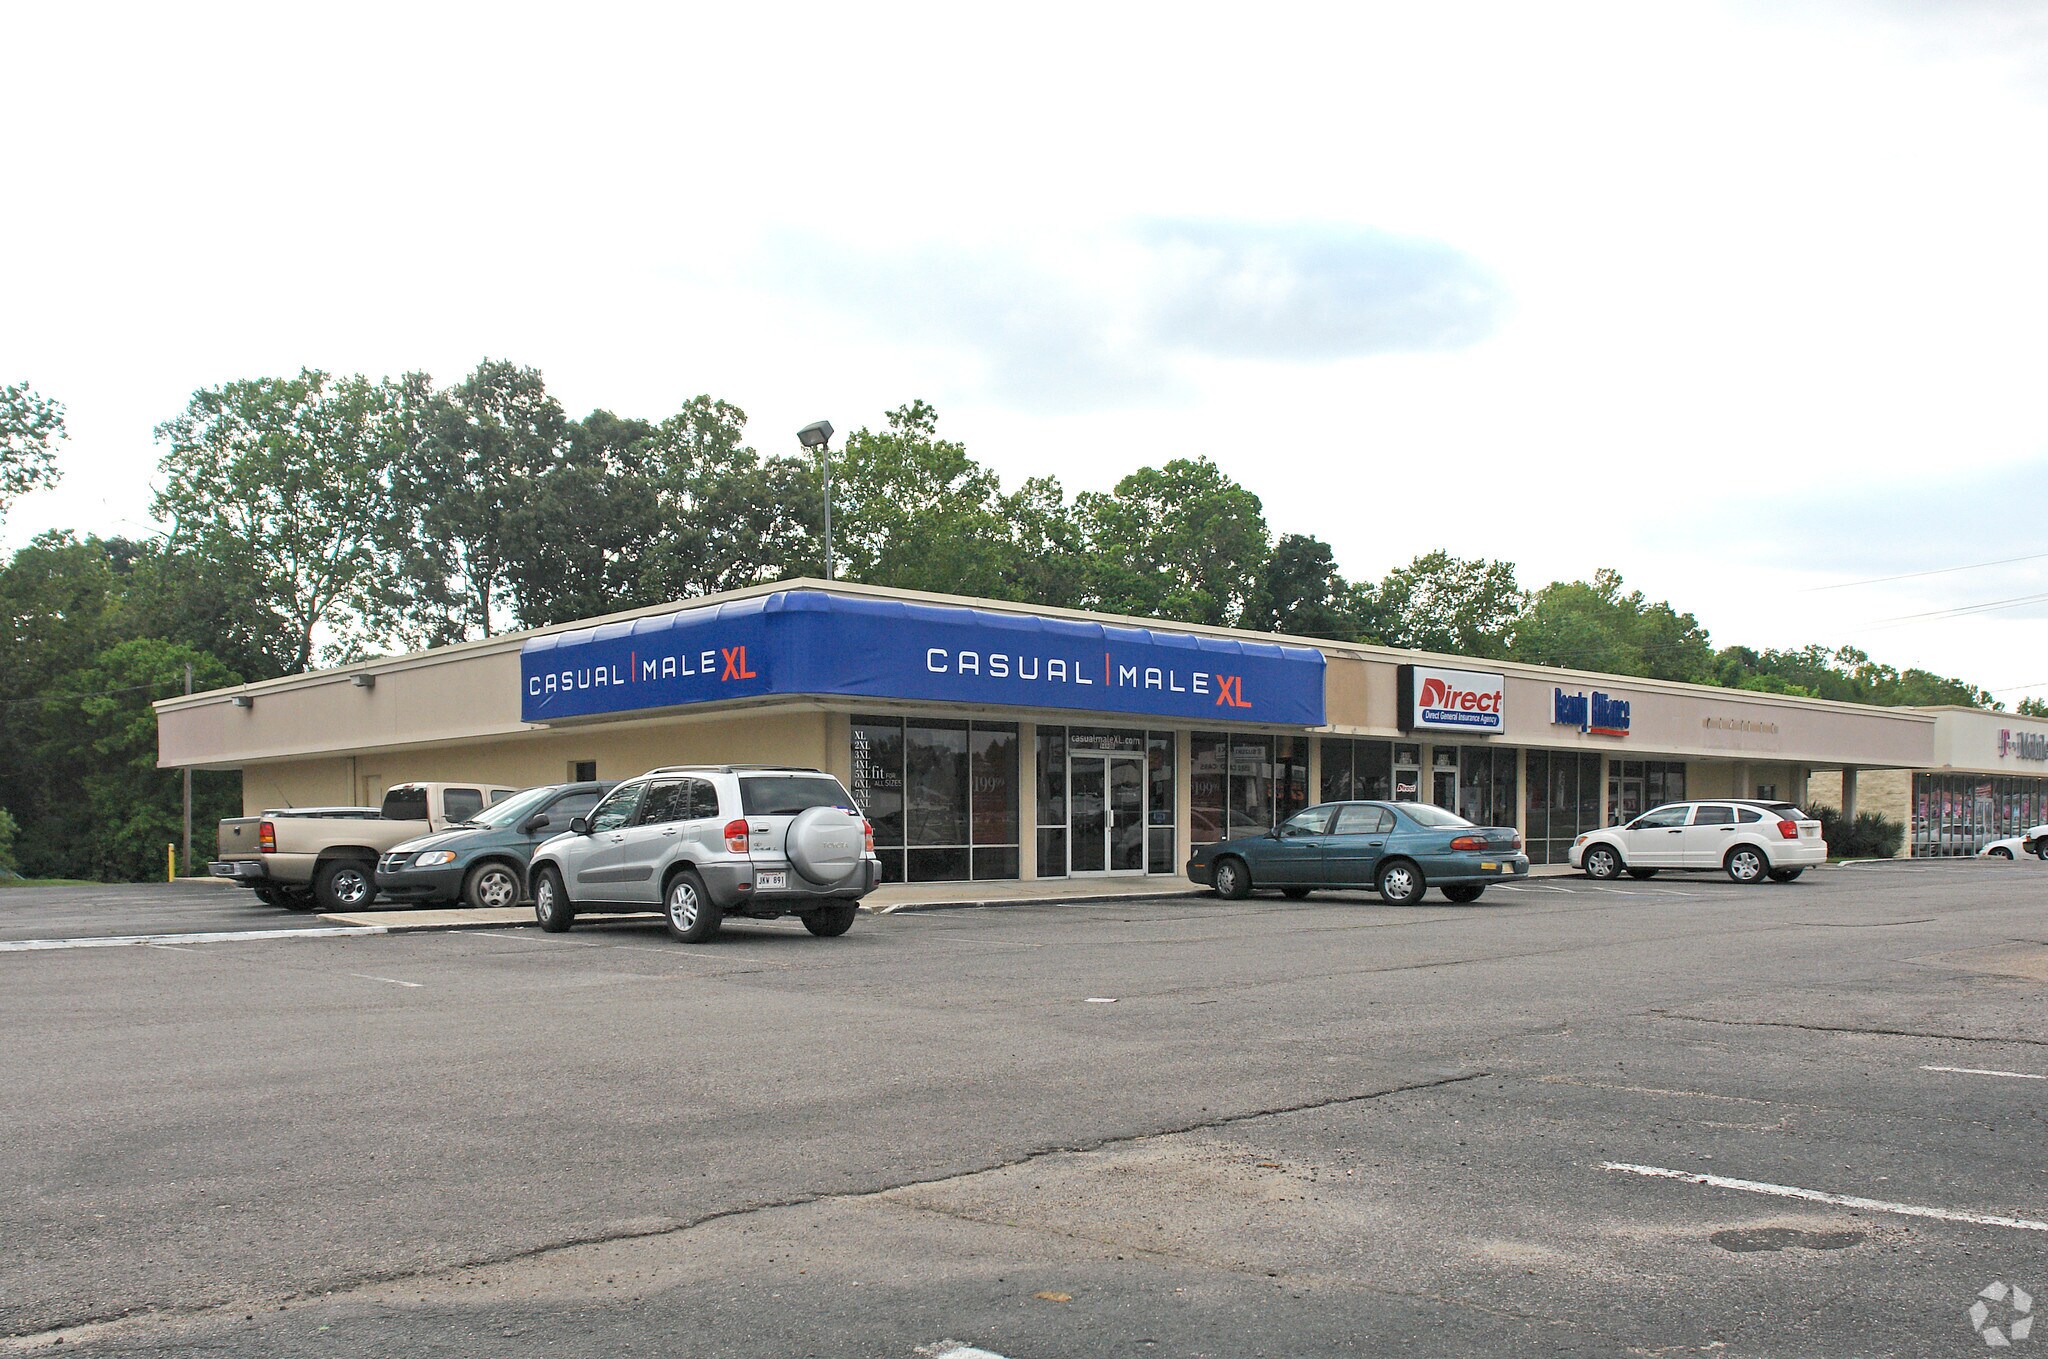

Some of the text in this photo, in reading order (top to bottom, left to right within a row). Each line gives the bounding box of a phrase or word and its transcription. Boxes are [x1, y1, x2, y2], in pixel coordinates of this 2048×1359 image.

[529, 645, 757, 696] CASUAL MALE XL
[926, 647, 1252, 708] CASUAL MALE XL
[1419, 677, 1503, 713] Direct
[1425, 710, 1497, 725] Direct General Insurance Agency
[854, 730, 867, 740] XL
[1071, 733, 1141, 745] casualmaleXL.com
[854, 741, 870, 750] 2XL
[854, 750, 871, 759] 3XL
[854, 760, 871, 769] 4XL
[854, 769, 871, 778] 5XL
[871, 765, 885, 779] fit
[854, 779, 871, 788] 6XL
[854, 789, 871, 798] 7XL
[823, 841, 849, 849] TOYOTA
[773, 876, 784, 884] 891
